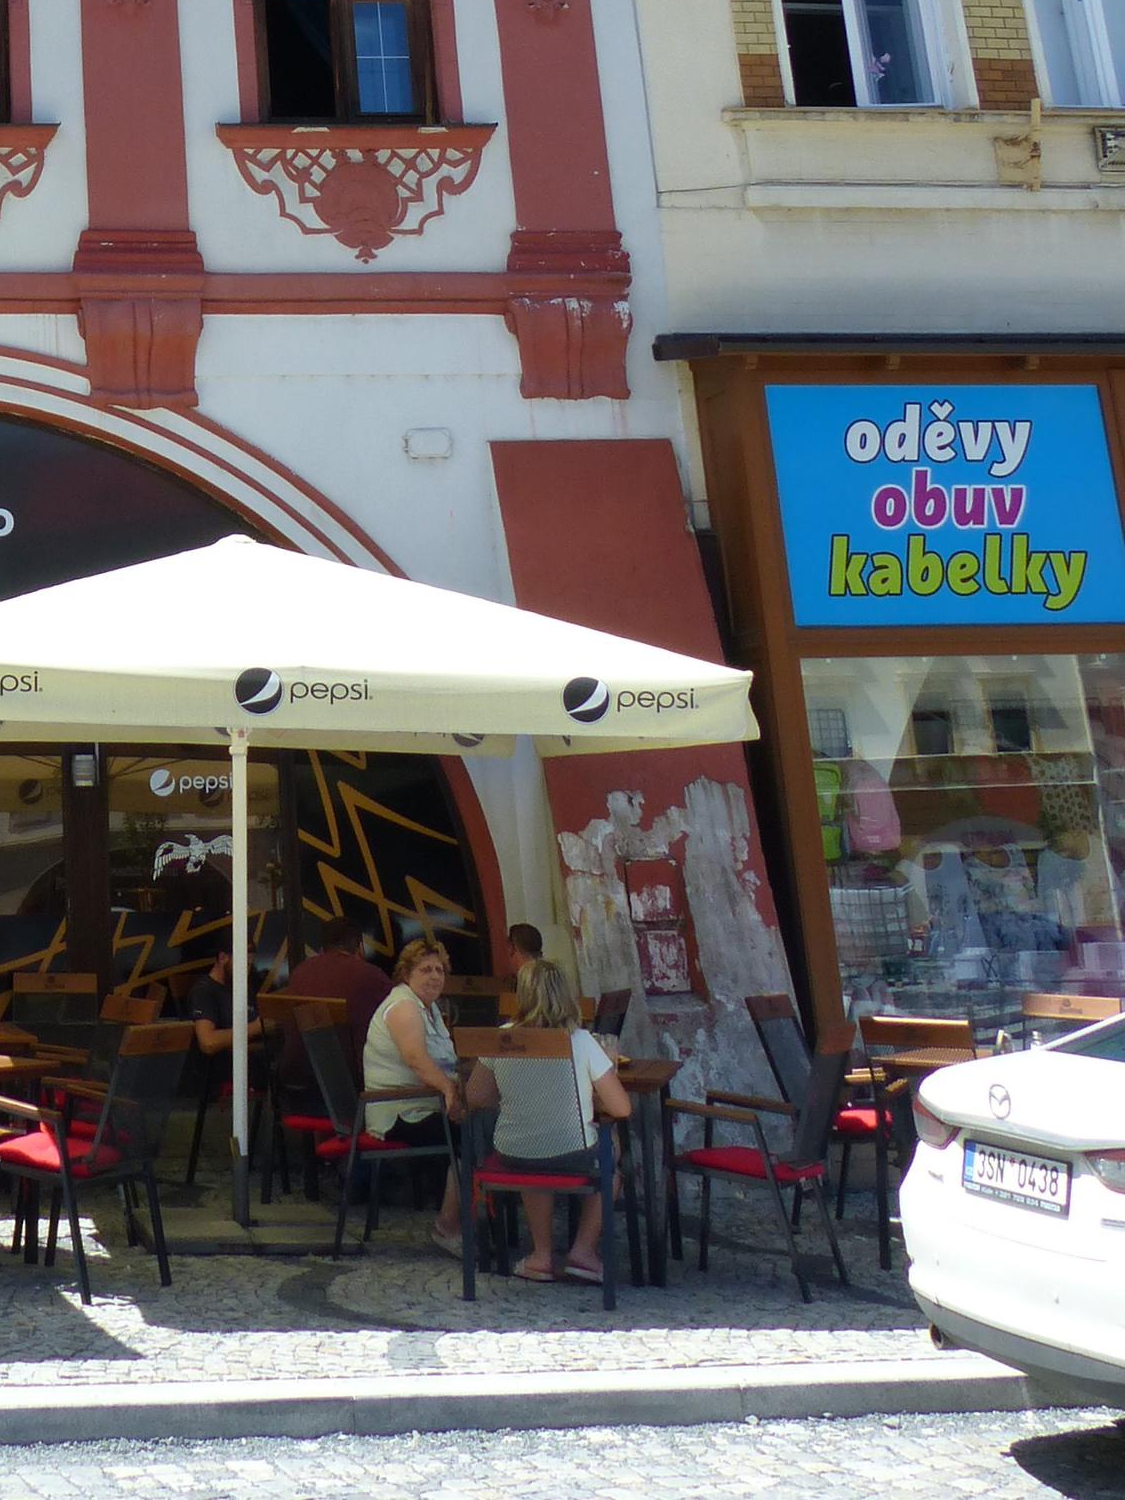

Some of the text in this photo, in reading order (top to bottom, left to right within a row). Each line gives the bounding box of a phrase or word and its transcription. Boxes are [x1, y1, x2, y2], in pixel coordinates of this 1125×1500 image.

[845, 400, 1032, 477] oděvy
[872, 467, 1026, 529] obuv
[829, 533, 1087, 611] kabelky
[290, 679, 368, 704] pepsi
[617, 688, 694, 713] pepsi
[180, 772, 233, 793] pepsi
[978, 1150, 1059, 1196] 3SN 0438
